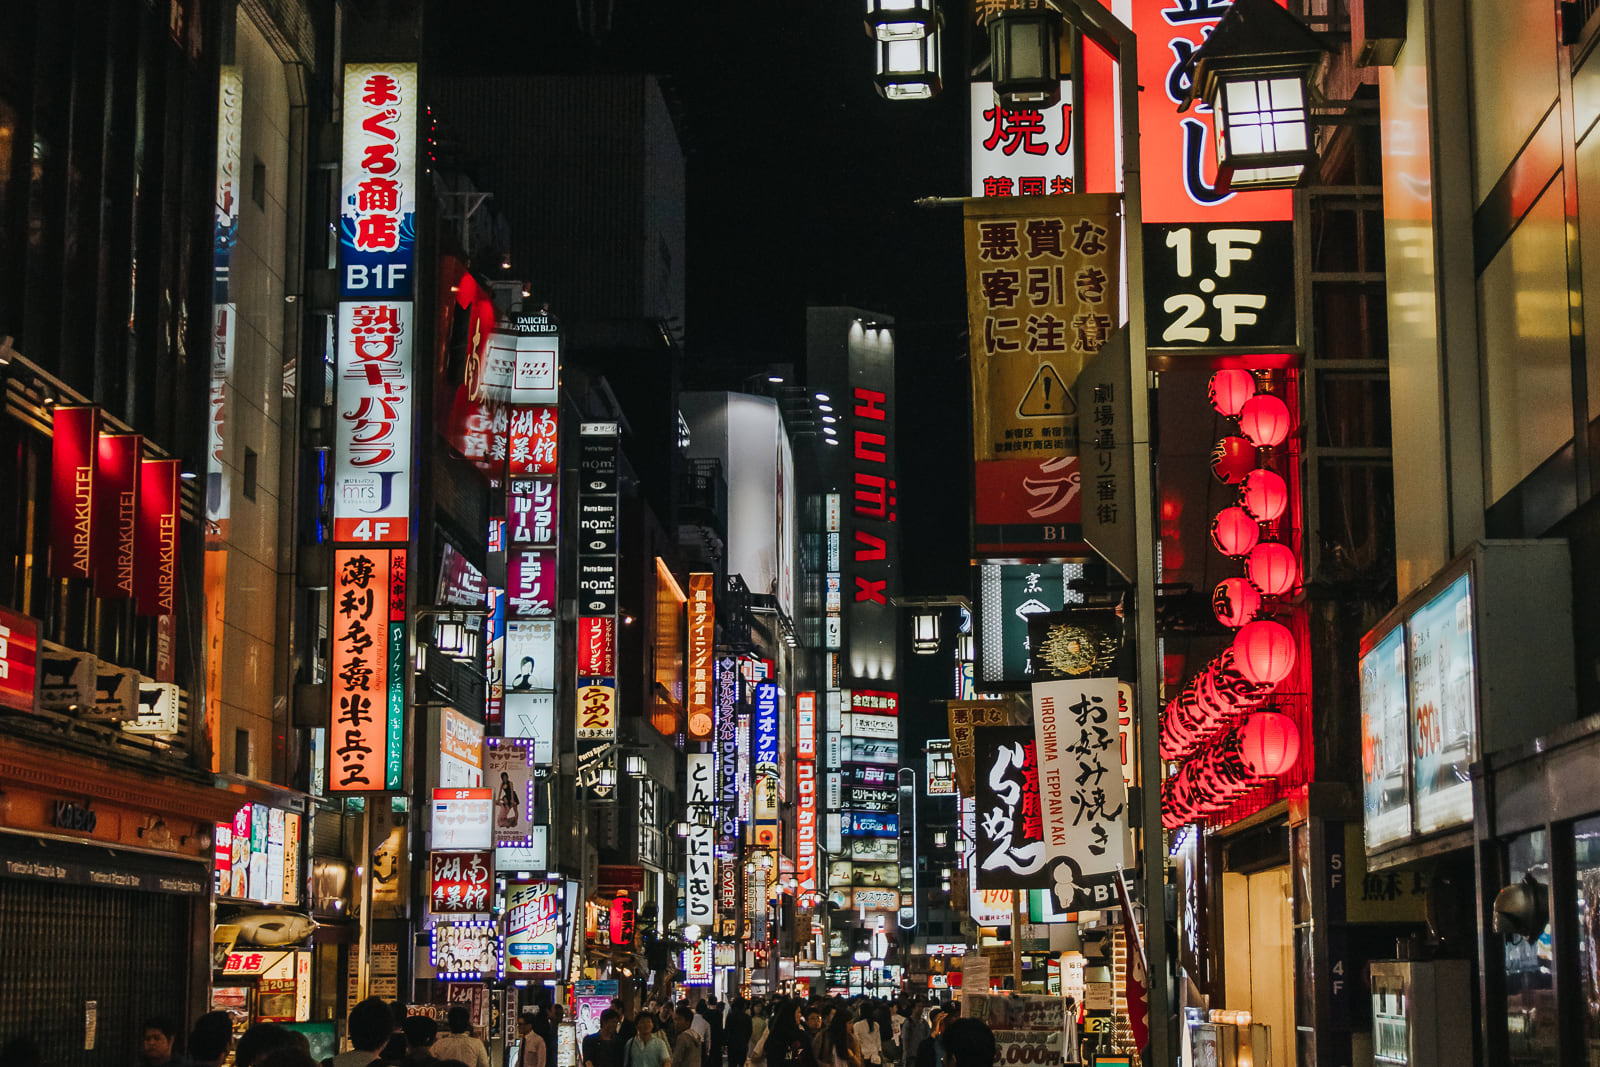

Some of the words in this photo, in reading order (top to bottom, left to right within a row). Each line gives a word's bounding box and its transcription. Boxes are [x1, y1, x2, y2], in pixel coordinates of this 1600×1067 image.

[360, 73, 402, 251] まぐろ商店
[978, 217, 1109, 262] 悪質な
[1165, 227, 1262, 278] 1F
[346, 264, 407, 290] B1F
[980, 265, 1109, 309] 客引き
[982, 312, 1112, 353] に注意
[1161, 293, 1266, 343] 2F
[343, 305, 407, 468] 熟女キャバクラ
[510, 409, 557, 437] 湖南
[510, 437, 557, 464] 菜館
[524, 463, 542, 473] 4F
[73, 466, 92, 573] ANRAKUTEI
[351, 519, 391, 541] 4F
[513, 496, 532, 542] ルーム
[534, 480, 553, 542] レンタル
[117, 491, 136, 593] ANRAKUTEI
[158, 513, 175, 610] ANRAKUTEI
[590, 618, 602, 676] リフレッシュ
[758, 684, 776, 750] カラオケ
[852, 694, 897, 710] 全店営業中
[1040, 696, 1058, 762] HIROSHIMA
[757, 751, 776, 762] 747
[1065, 693, 1123, 856] お好み焼き
[455, 791, 470, 799] 2F
[766, 777, 777, 809] 麻雀
[1046, 767, 1066, 847] TEPPANYAKI
[434, 852, 490, 883] 湖南
[508, 893, 556, 934] 出会い
[511, 880, 551, 905] キラリ
[526, 917, 556, 943] カフェ
[936, 945, 964, 953] コーヒー
[225, 953, 264, 971] 商店
